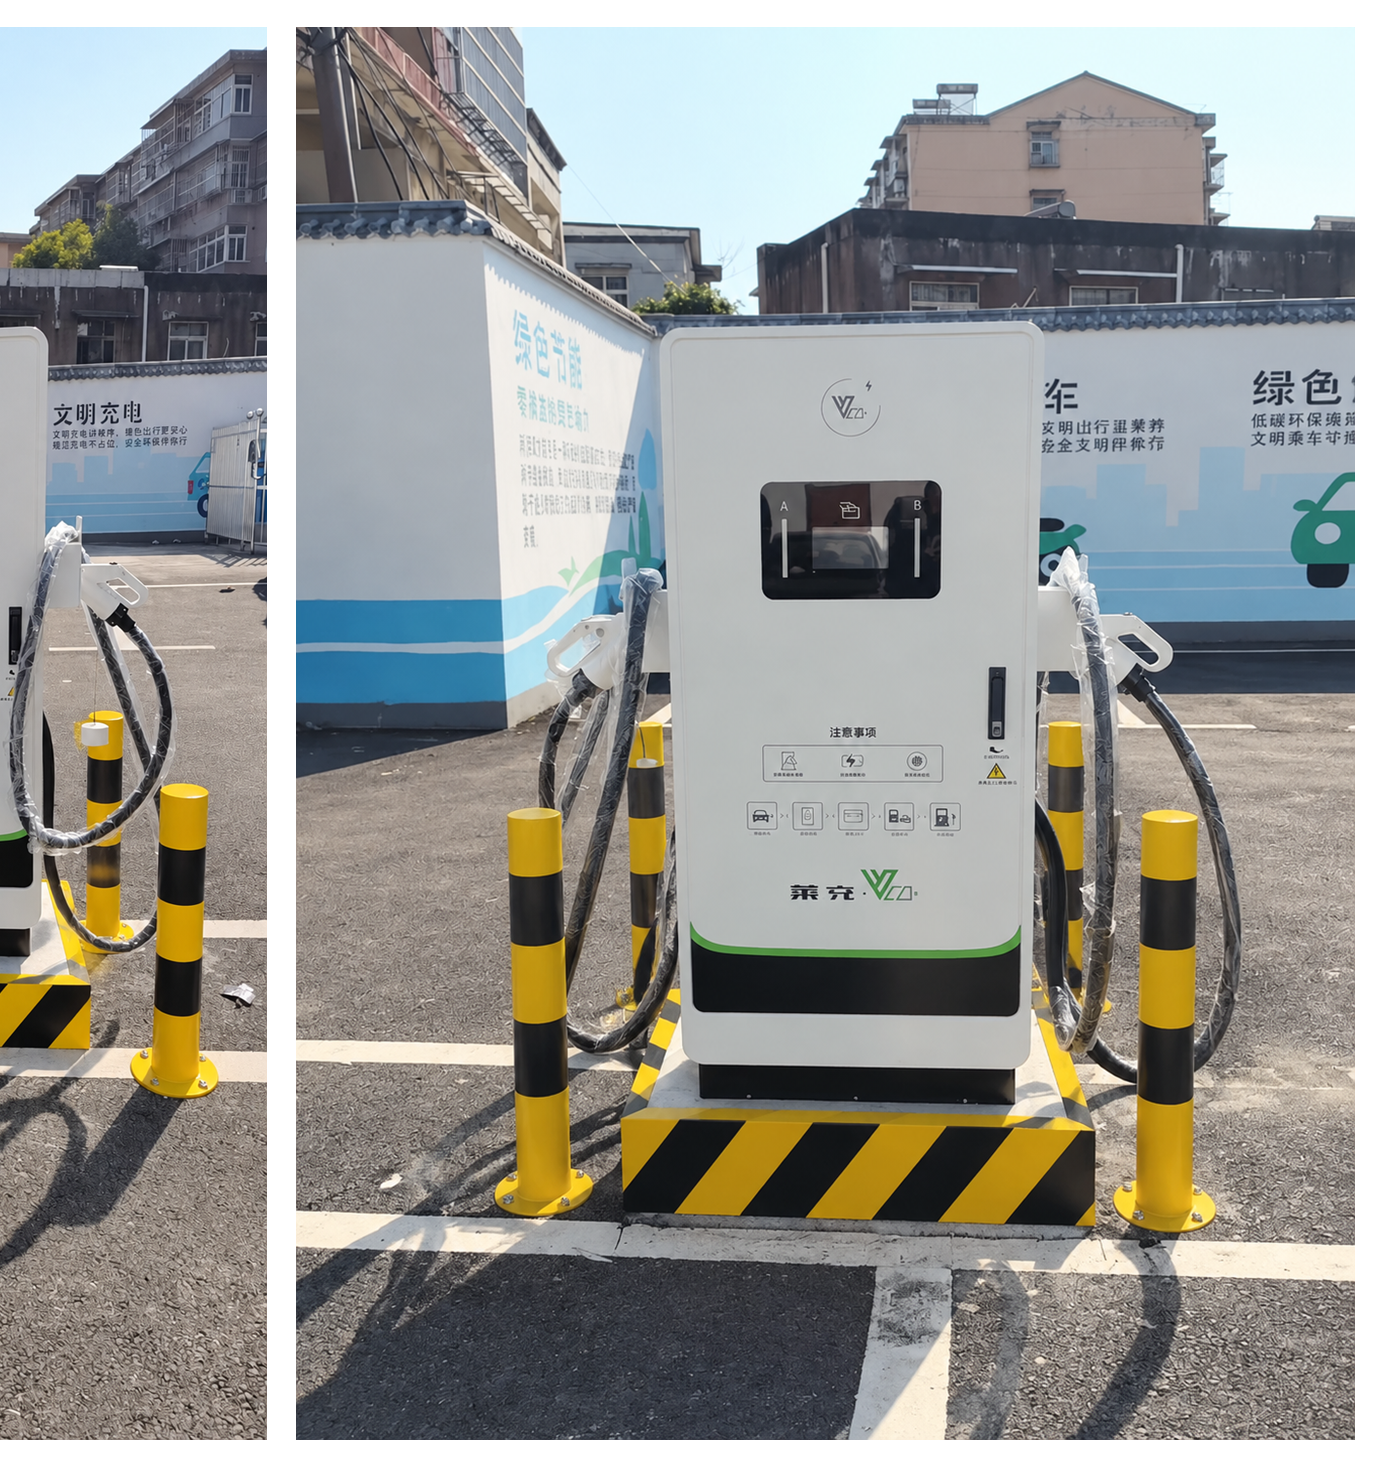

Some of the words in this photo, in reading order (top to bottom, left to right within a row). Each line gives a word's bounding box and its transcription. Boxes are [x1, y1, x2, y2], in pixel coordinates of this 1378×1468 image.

[1252, 368, 1355, 406] 绿色
[53, 400, 143, 426] 文明充电
[779, 501, 789, 512] A
[913, 500, 922, 511] B
[829, 726, 877, 738] 注意事项
